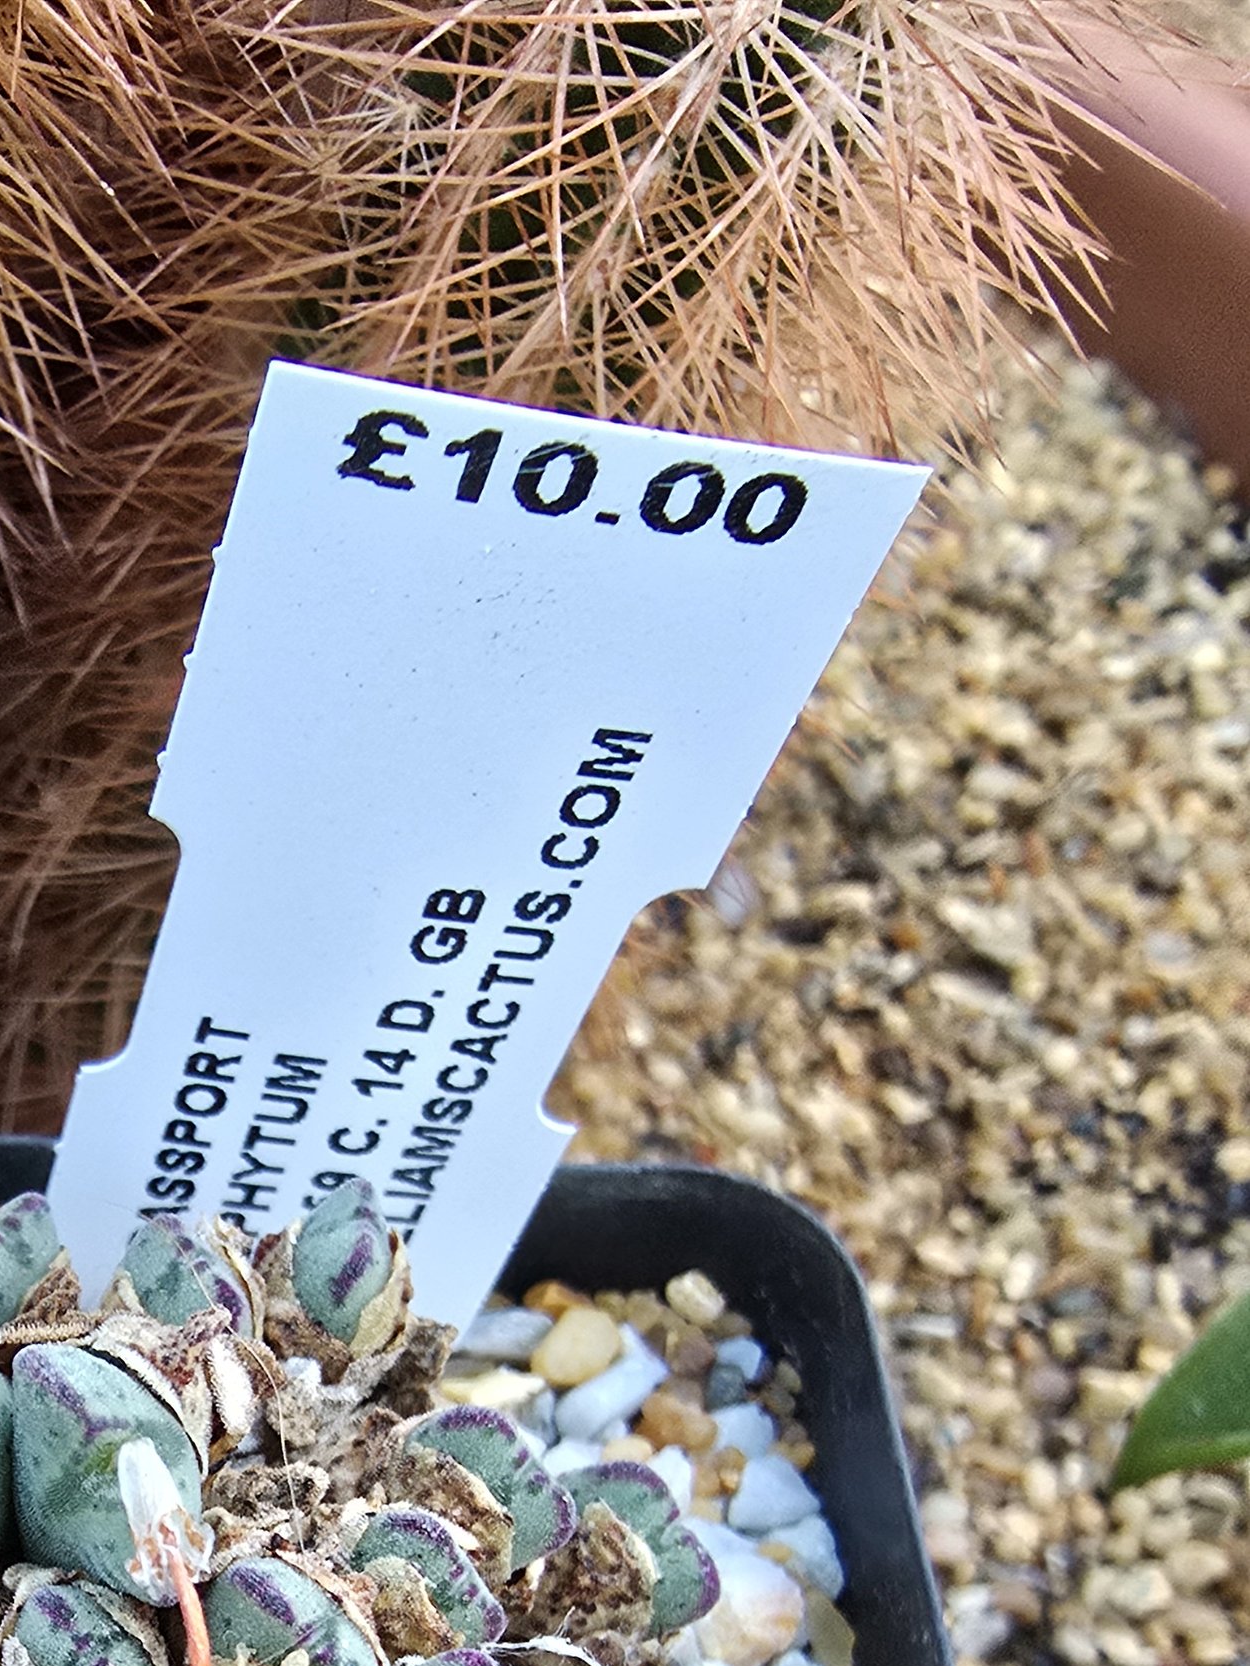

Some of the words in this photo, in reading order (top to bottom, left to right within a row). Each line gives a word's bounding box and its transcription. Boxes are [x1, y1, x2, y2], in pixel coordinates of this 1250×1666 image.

[337, 409, 809, 545] £10.00
[409, 887, 487, 965] GB
[376, 988, 446, 1033] D.
[383, 727, 654, 1245] LIAMSCACTUS.COM
[351, 1049, 417, 1097] 14
[129, 1015, 251, 1244] ASSPORT
[327, 1118, 388, 1156] C.
